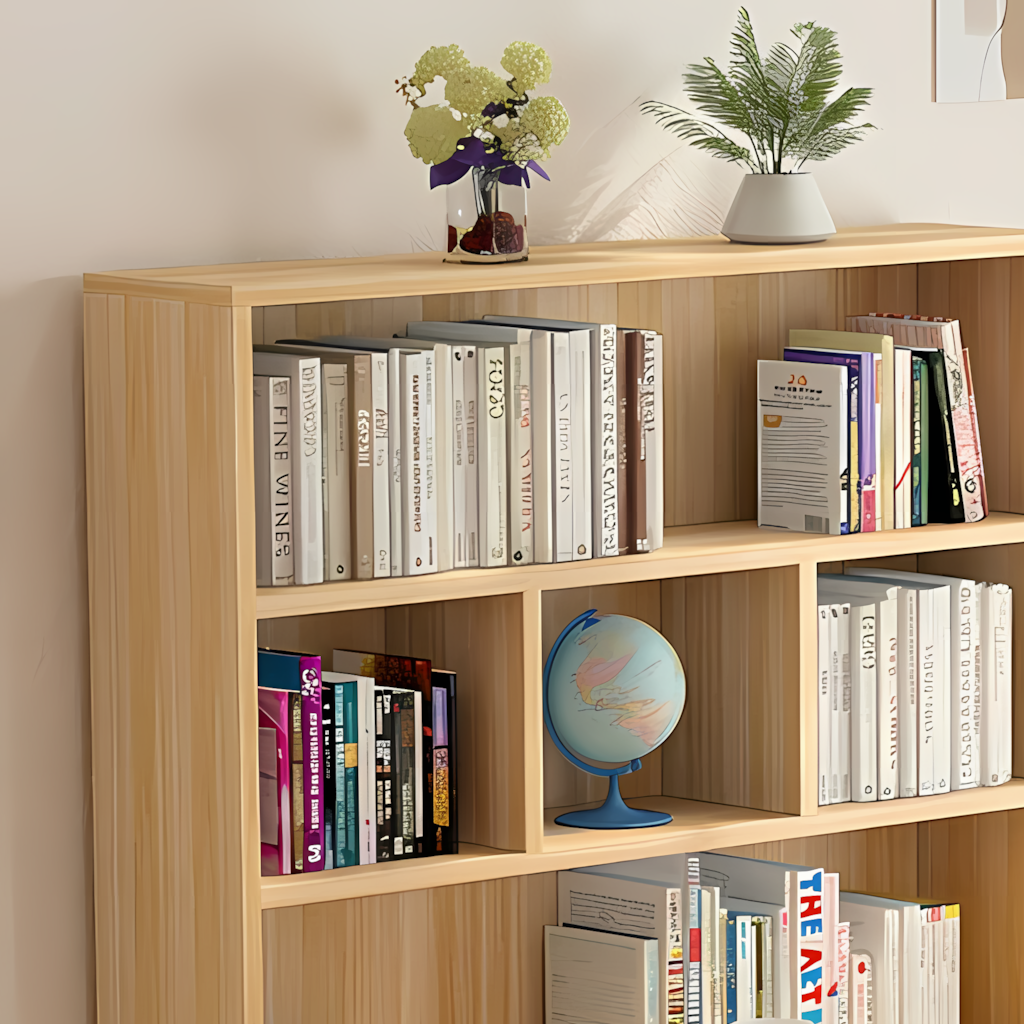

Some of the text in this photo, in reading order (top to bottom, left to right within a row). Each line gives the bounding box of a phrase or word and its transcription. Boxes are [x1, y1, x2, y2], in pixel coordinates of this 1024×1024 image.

[273, 406, 289, 460] FINE
[800, 871, 823, 937] THE
[800, 948, 823, 1004] ART
